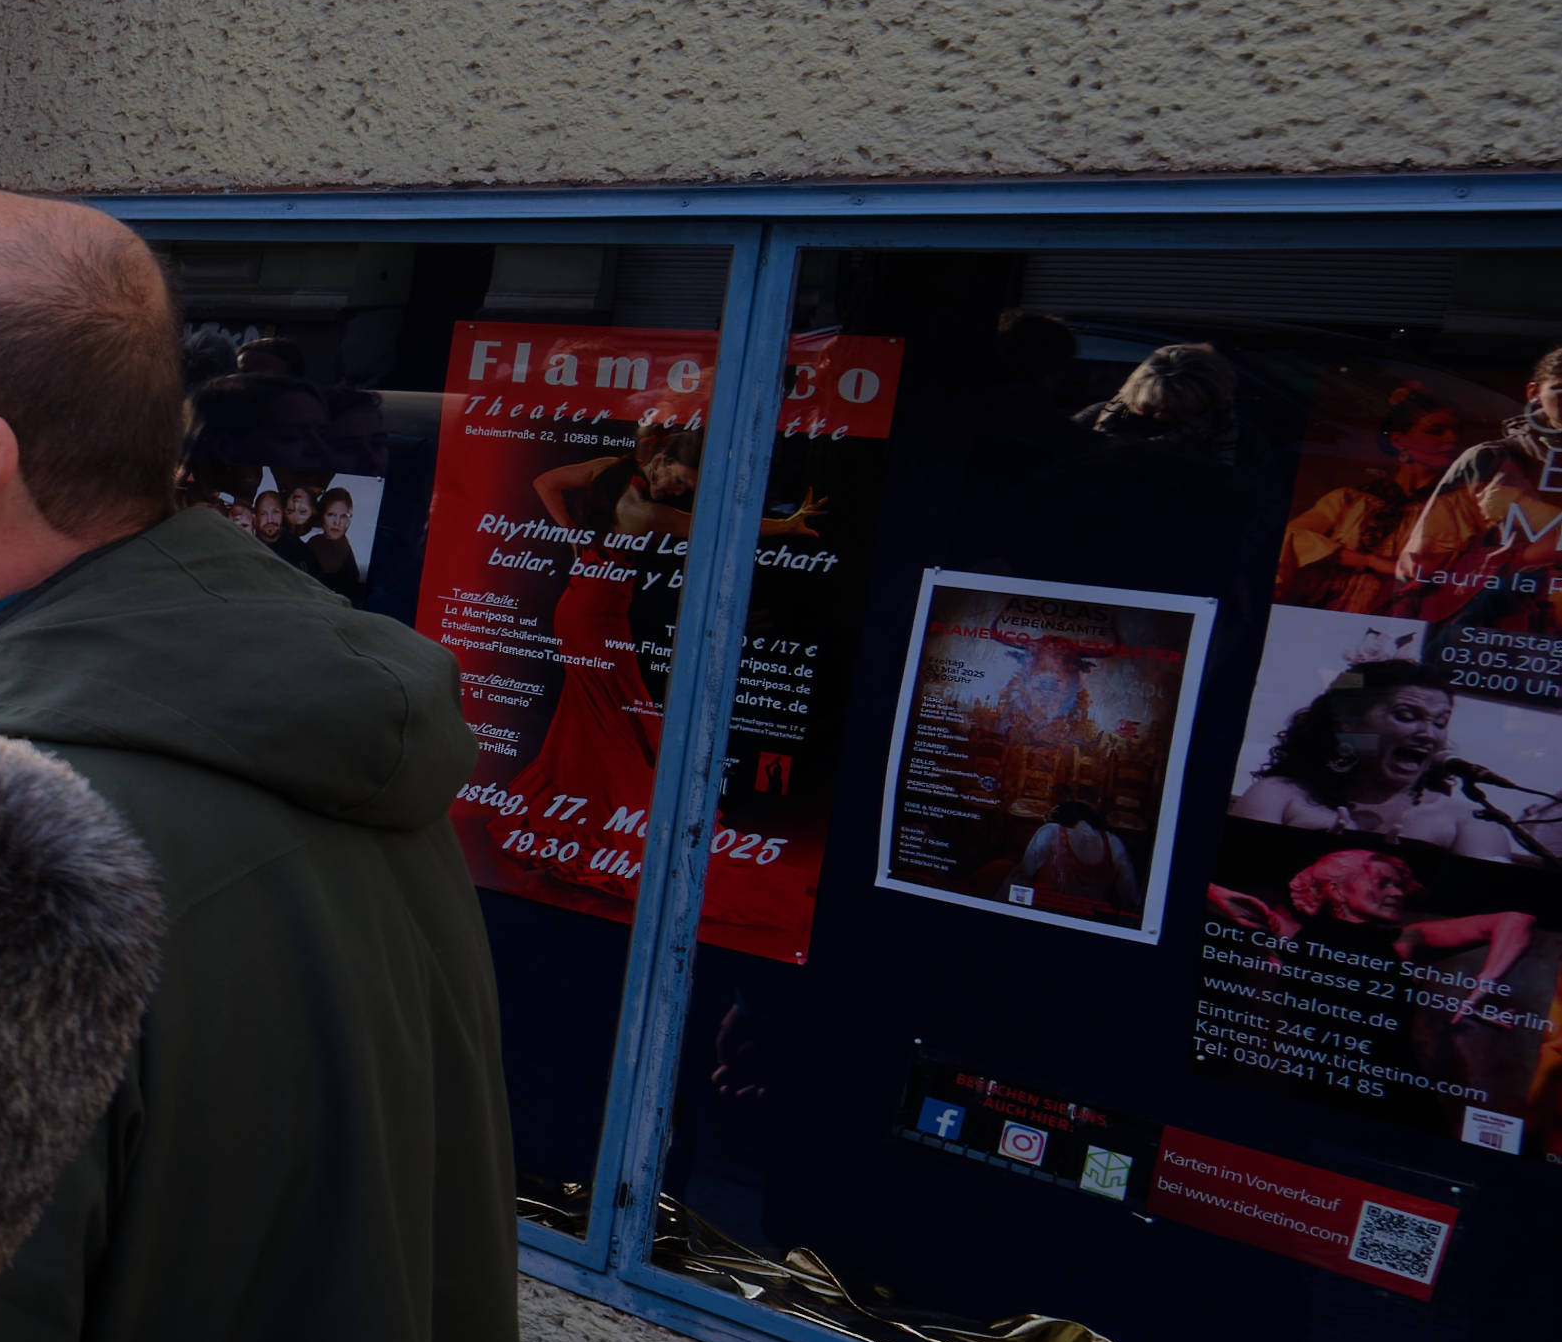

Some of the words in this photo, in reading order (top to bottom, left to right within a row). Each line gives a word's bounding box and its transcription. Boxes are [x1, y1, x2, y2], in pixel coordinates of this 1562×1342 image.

[467, 339, 881, 403] Flameco
[464, 394, 617, 426] Theater
[637, 407, 850, 441] Schtte
[464, 424, 538, 442] Behaimstraße
[563, 432, 599, 446] 10585
[602, 434, 637, 449] Berlin
[477, 512, 595, 549] Rhythmus
[604, 528, 650, 554] und
[488, 547, 558, 578] bailar,
[569, 556, 638, 584] bailar
[642, 570, 662, 591] y
[1415, 564, 1501, 590] Laura
[1510, 572, 1538, 594] la
[444, 604, 458, 615] La
[462, 606, 515, 625] Mariposa
[519, 616, 538, 627] und
[460, 671, 546, 695] arre/Guitarra:
[1441, 645, 1562, 676] 03.05.202
[1448, 669, 1519, 692] 20:00
[1525, 678, 1561, 698] Uh
[456, 781, 530, 817] stag,
[542, 793, 588, 826] 17.
[710, 828, 789, 866] 025
[501, 828, 581, 864] 19.30
[589, 847, 641, 880] Uhr
[1204, 921, 1245, 943] Ort:
[1305, 940, 1394, 973] Theater
[1399, 961, 1512, 997] Schalotte
[1202, 945, 1361, 993] Behaimstrasse
[1366, 980, 1395, 1000] 22
[1404, 988, 1473, 1017] 10585
[1480, 1004, 1554, 1033] Berlin
[1203, 975, 1399, 1032] www.schalotte.de
[1196, 1000, 1270, 1031] Eintritt:
[1275, 1019, 1317, 1042] 24€
[1320, 1029, 1373, 1056] /19€
[1193, 1036, 1228, 1059] Tel:
[1233, 1046, 1316, 1081] 030/341
[1325, 1069, 1351, 1090] 14
[1356, 1077, 1385, 1099] 85
[1195, 1018, 1269, 1050] Karten:
[1273, 1039, 1488, 1103] www.ticketino.com
[1163, 1149, 1218, 1177] Karten
[1220, 1165, 1243, 1184] im
[1245, 1172, 1343, 1212] Vorverkauf
[1156, 1175, 1184, 1195] bei
[1184, 1187, 1350, 1247] www.ticketino.com
